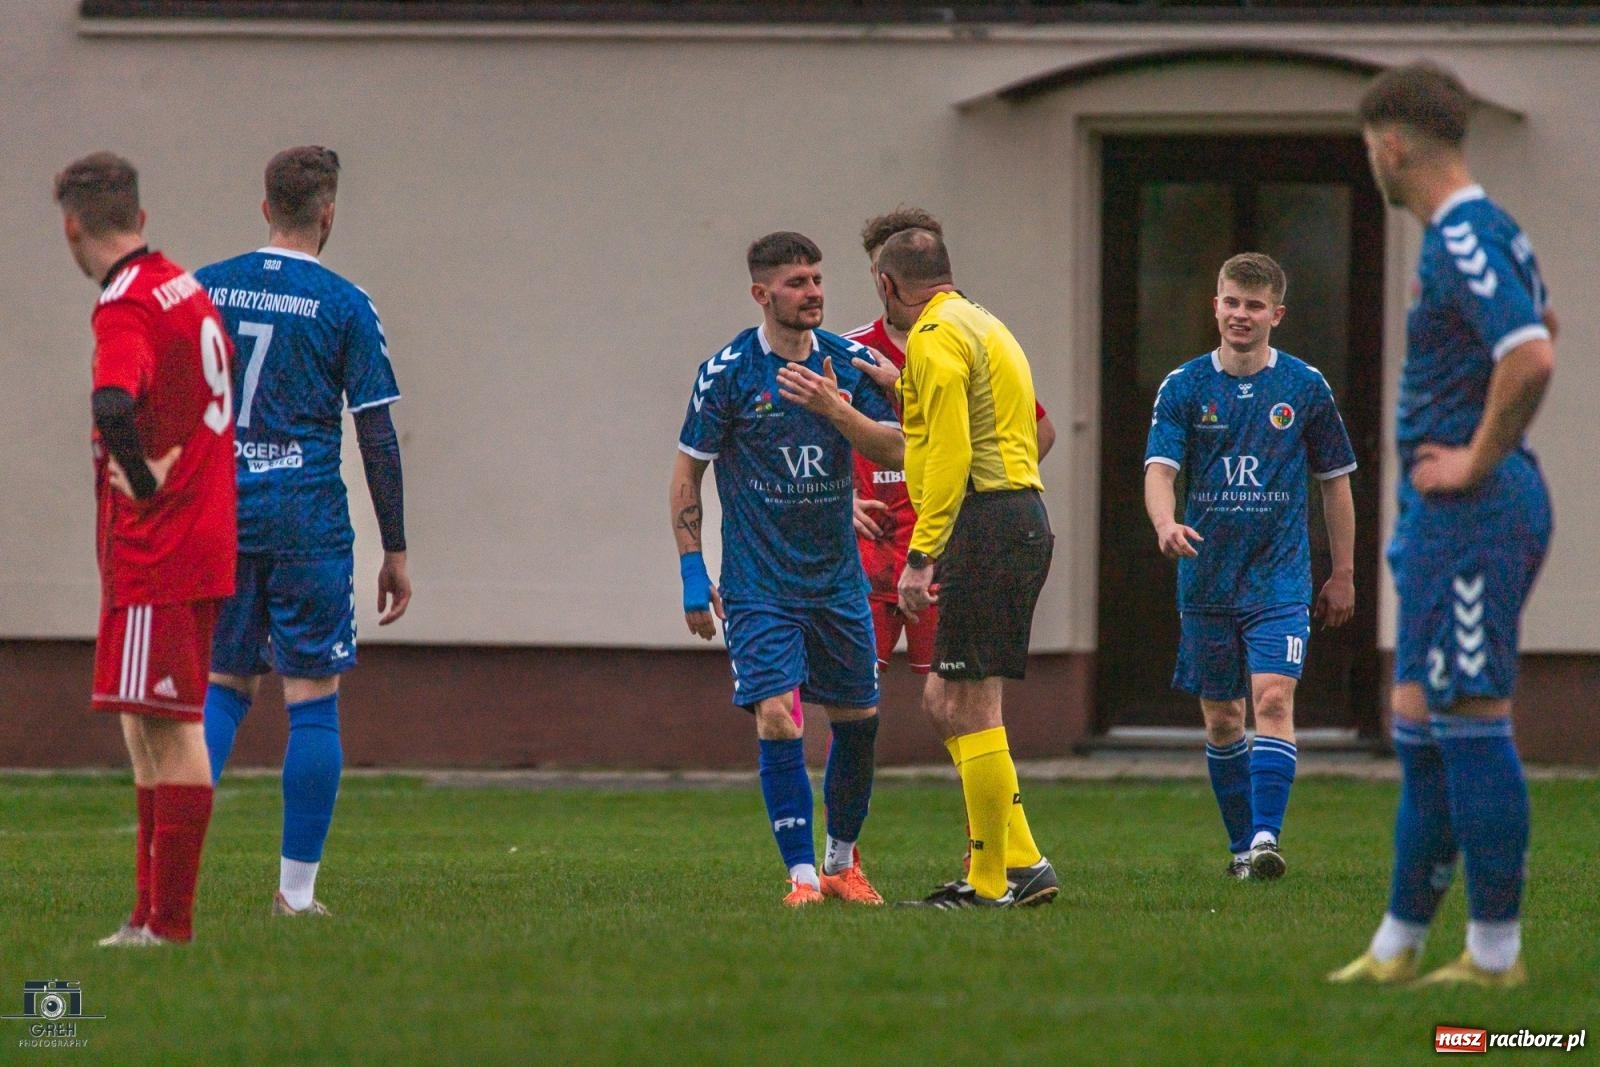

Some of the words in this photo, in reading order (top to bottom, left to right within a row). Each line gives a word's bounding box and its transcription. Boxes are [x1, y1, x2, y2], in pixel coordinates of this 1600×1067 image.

[228, 288, 320, 318] KRZYŻANOWICE
[201, 315, 233, 436] 9
[236, 320, 274, 428] 7
[778, 445, 829, 478] VR
[1222, 455, 1263, 487] VR
[1286, 635, 1303, 664] 10
